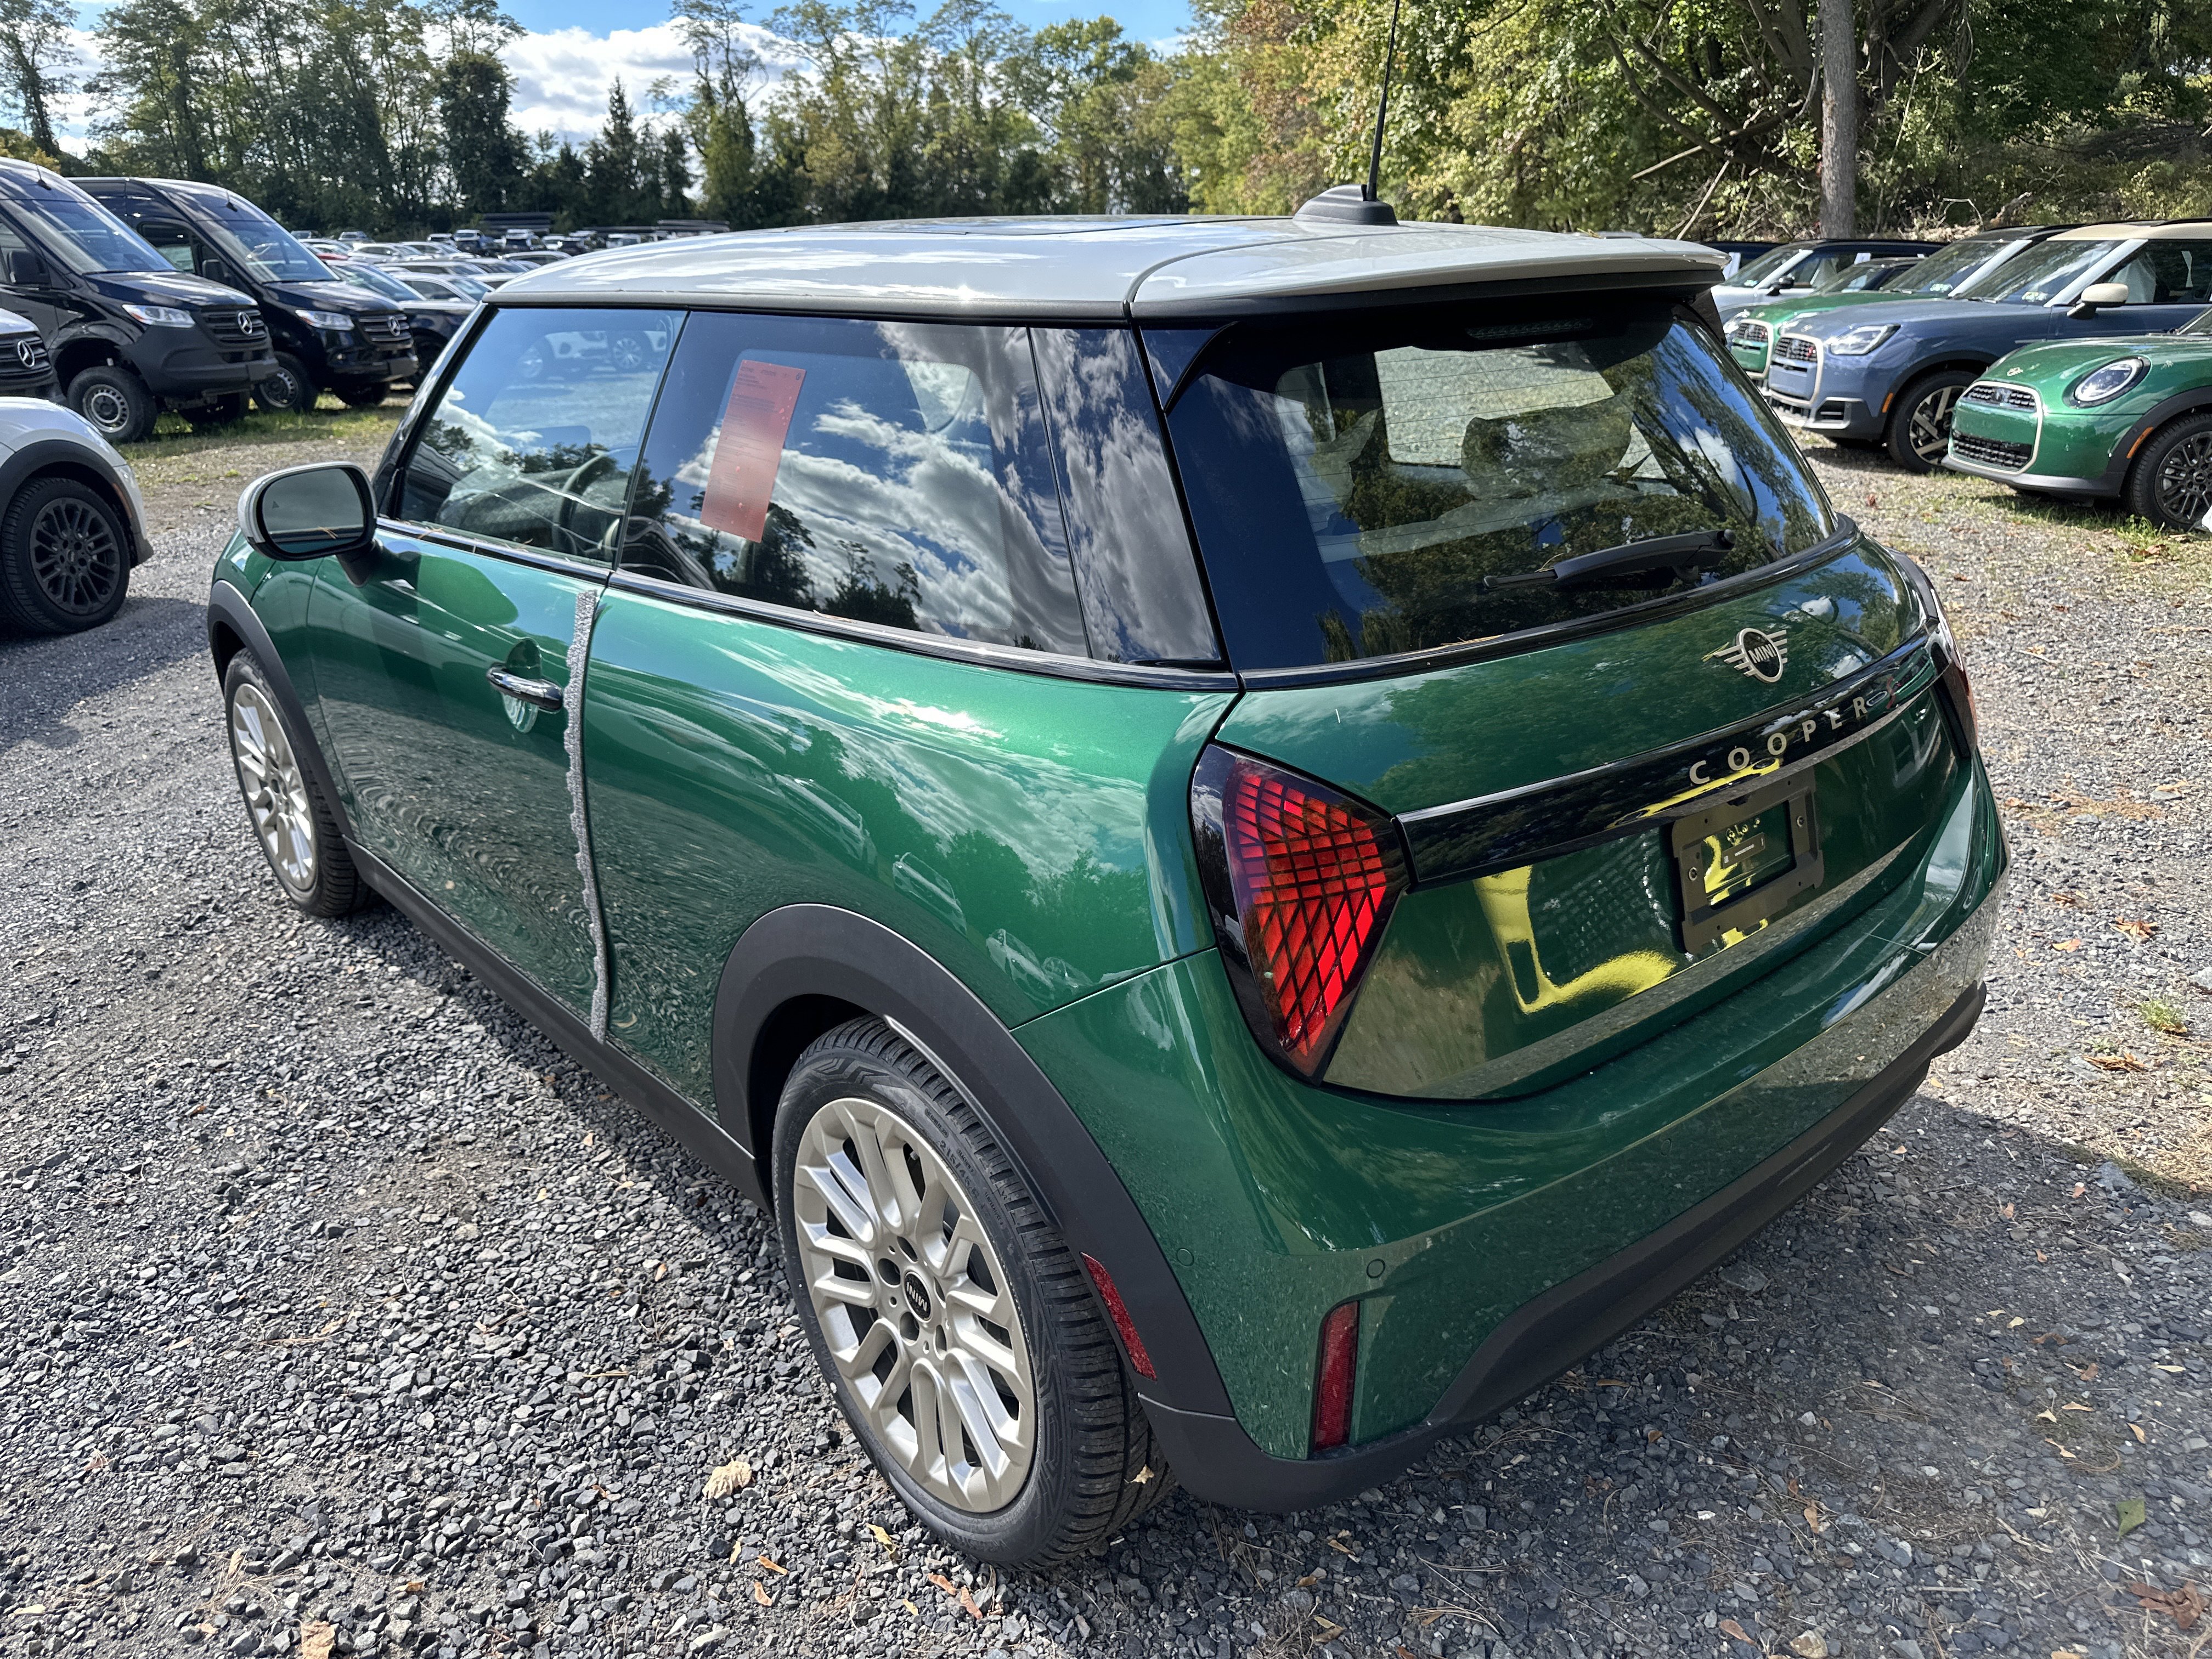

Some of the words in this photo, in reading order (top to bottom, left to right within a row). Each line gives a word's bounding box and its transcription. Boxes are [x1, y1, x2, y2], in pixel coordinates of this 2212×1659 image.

[1748, 643, 1777, 664] MINI
[1689, 696, 1868, 785] COOPER
[906, 1282, 928, 1312] MINI
